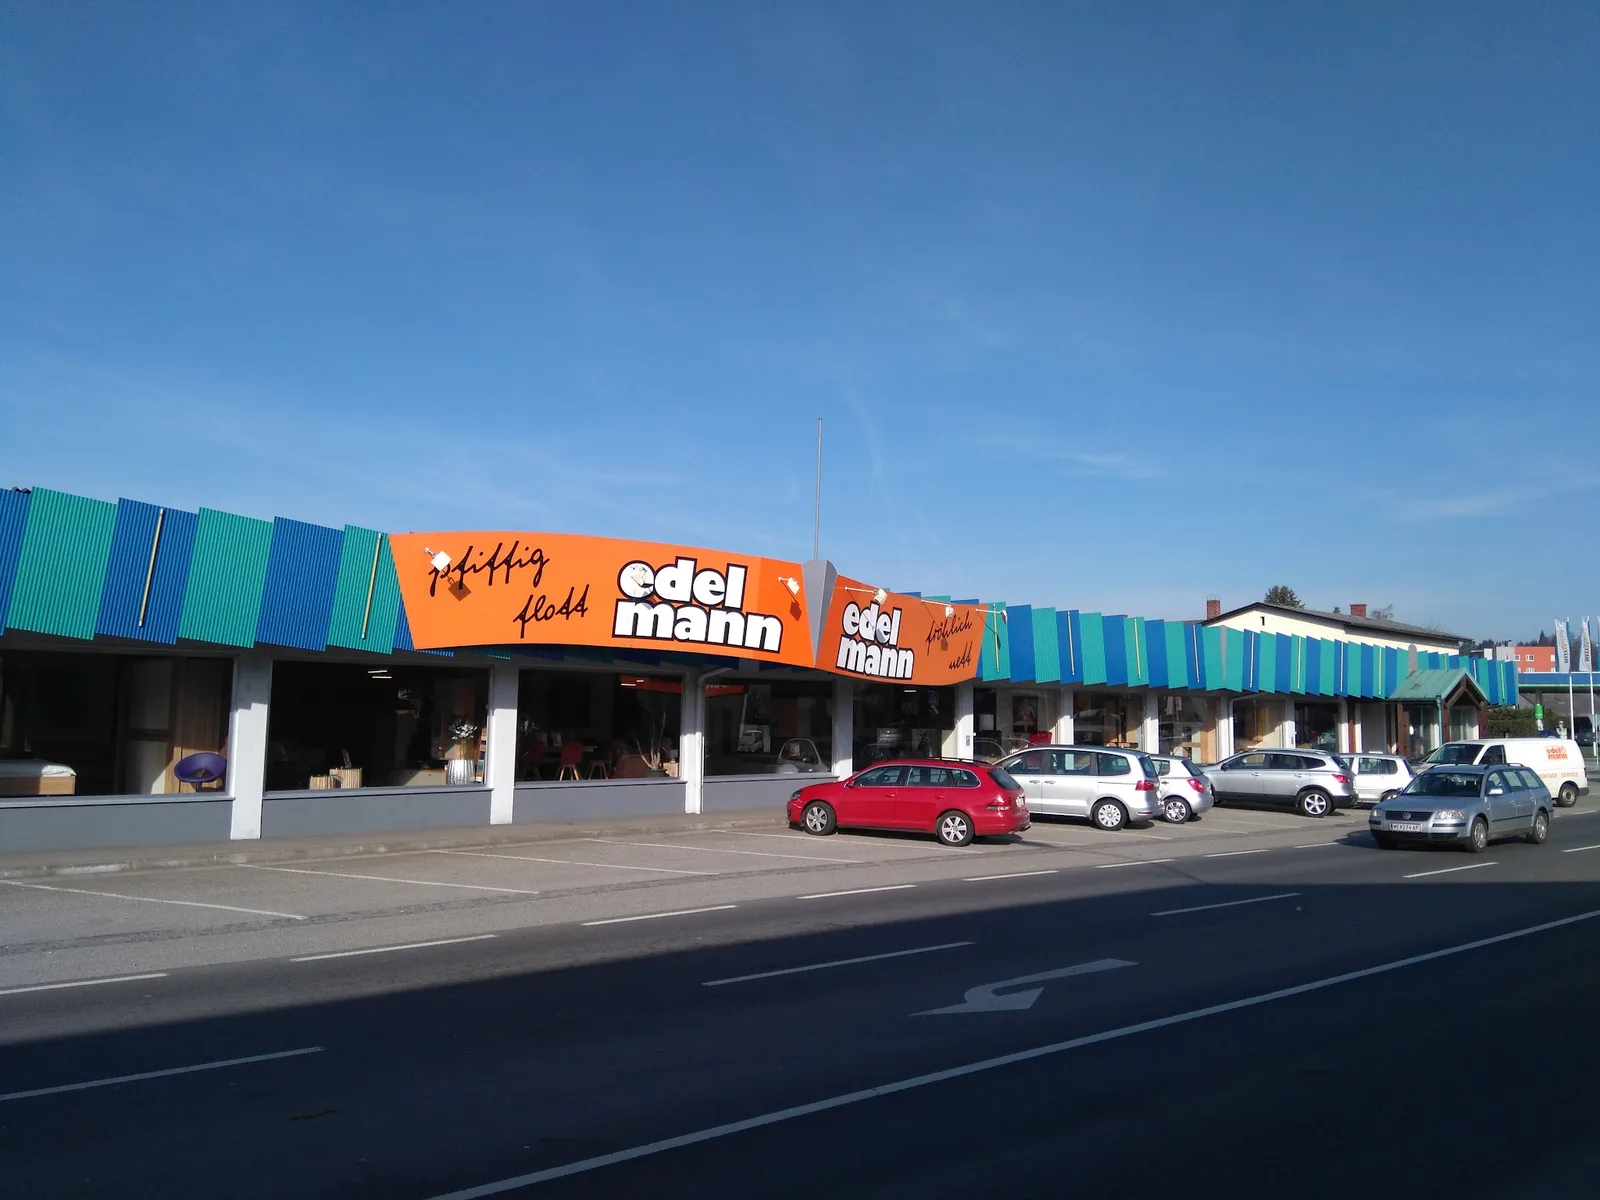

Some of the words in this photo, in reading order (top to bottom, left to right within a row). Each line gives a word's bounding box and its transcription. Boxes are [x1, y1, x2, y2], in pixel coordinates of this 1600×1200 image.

[428, 540, 550, 597] pfiffig
[617, 556, 748, 611] edel
[512, 583, 590, 639] flott
[612, 599, 783, 654] mann
[842, 600, 902, 646] edel
[836, 634, 914, 680] mann
[948, 641, 973, 670] nett
